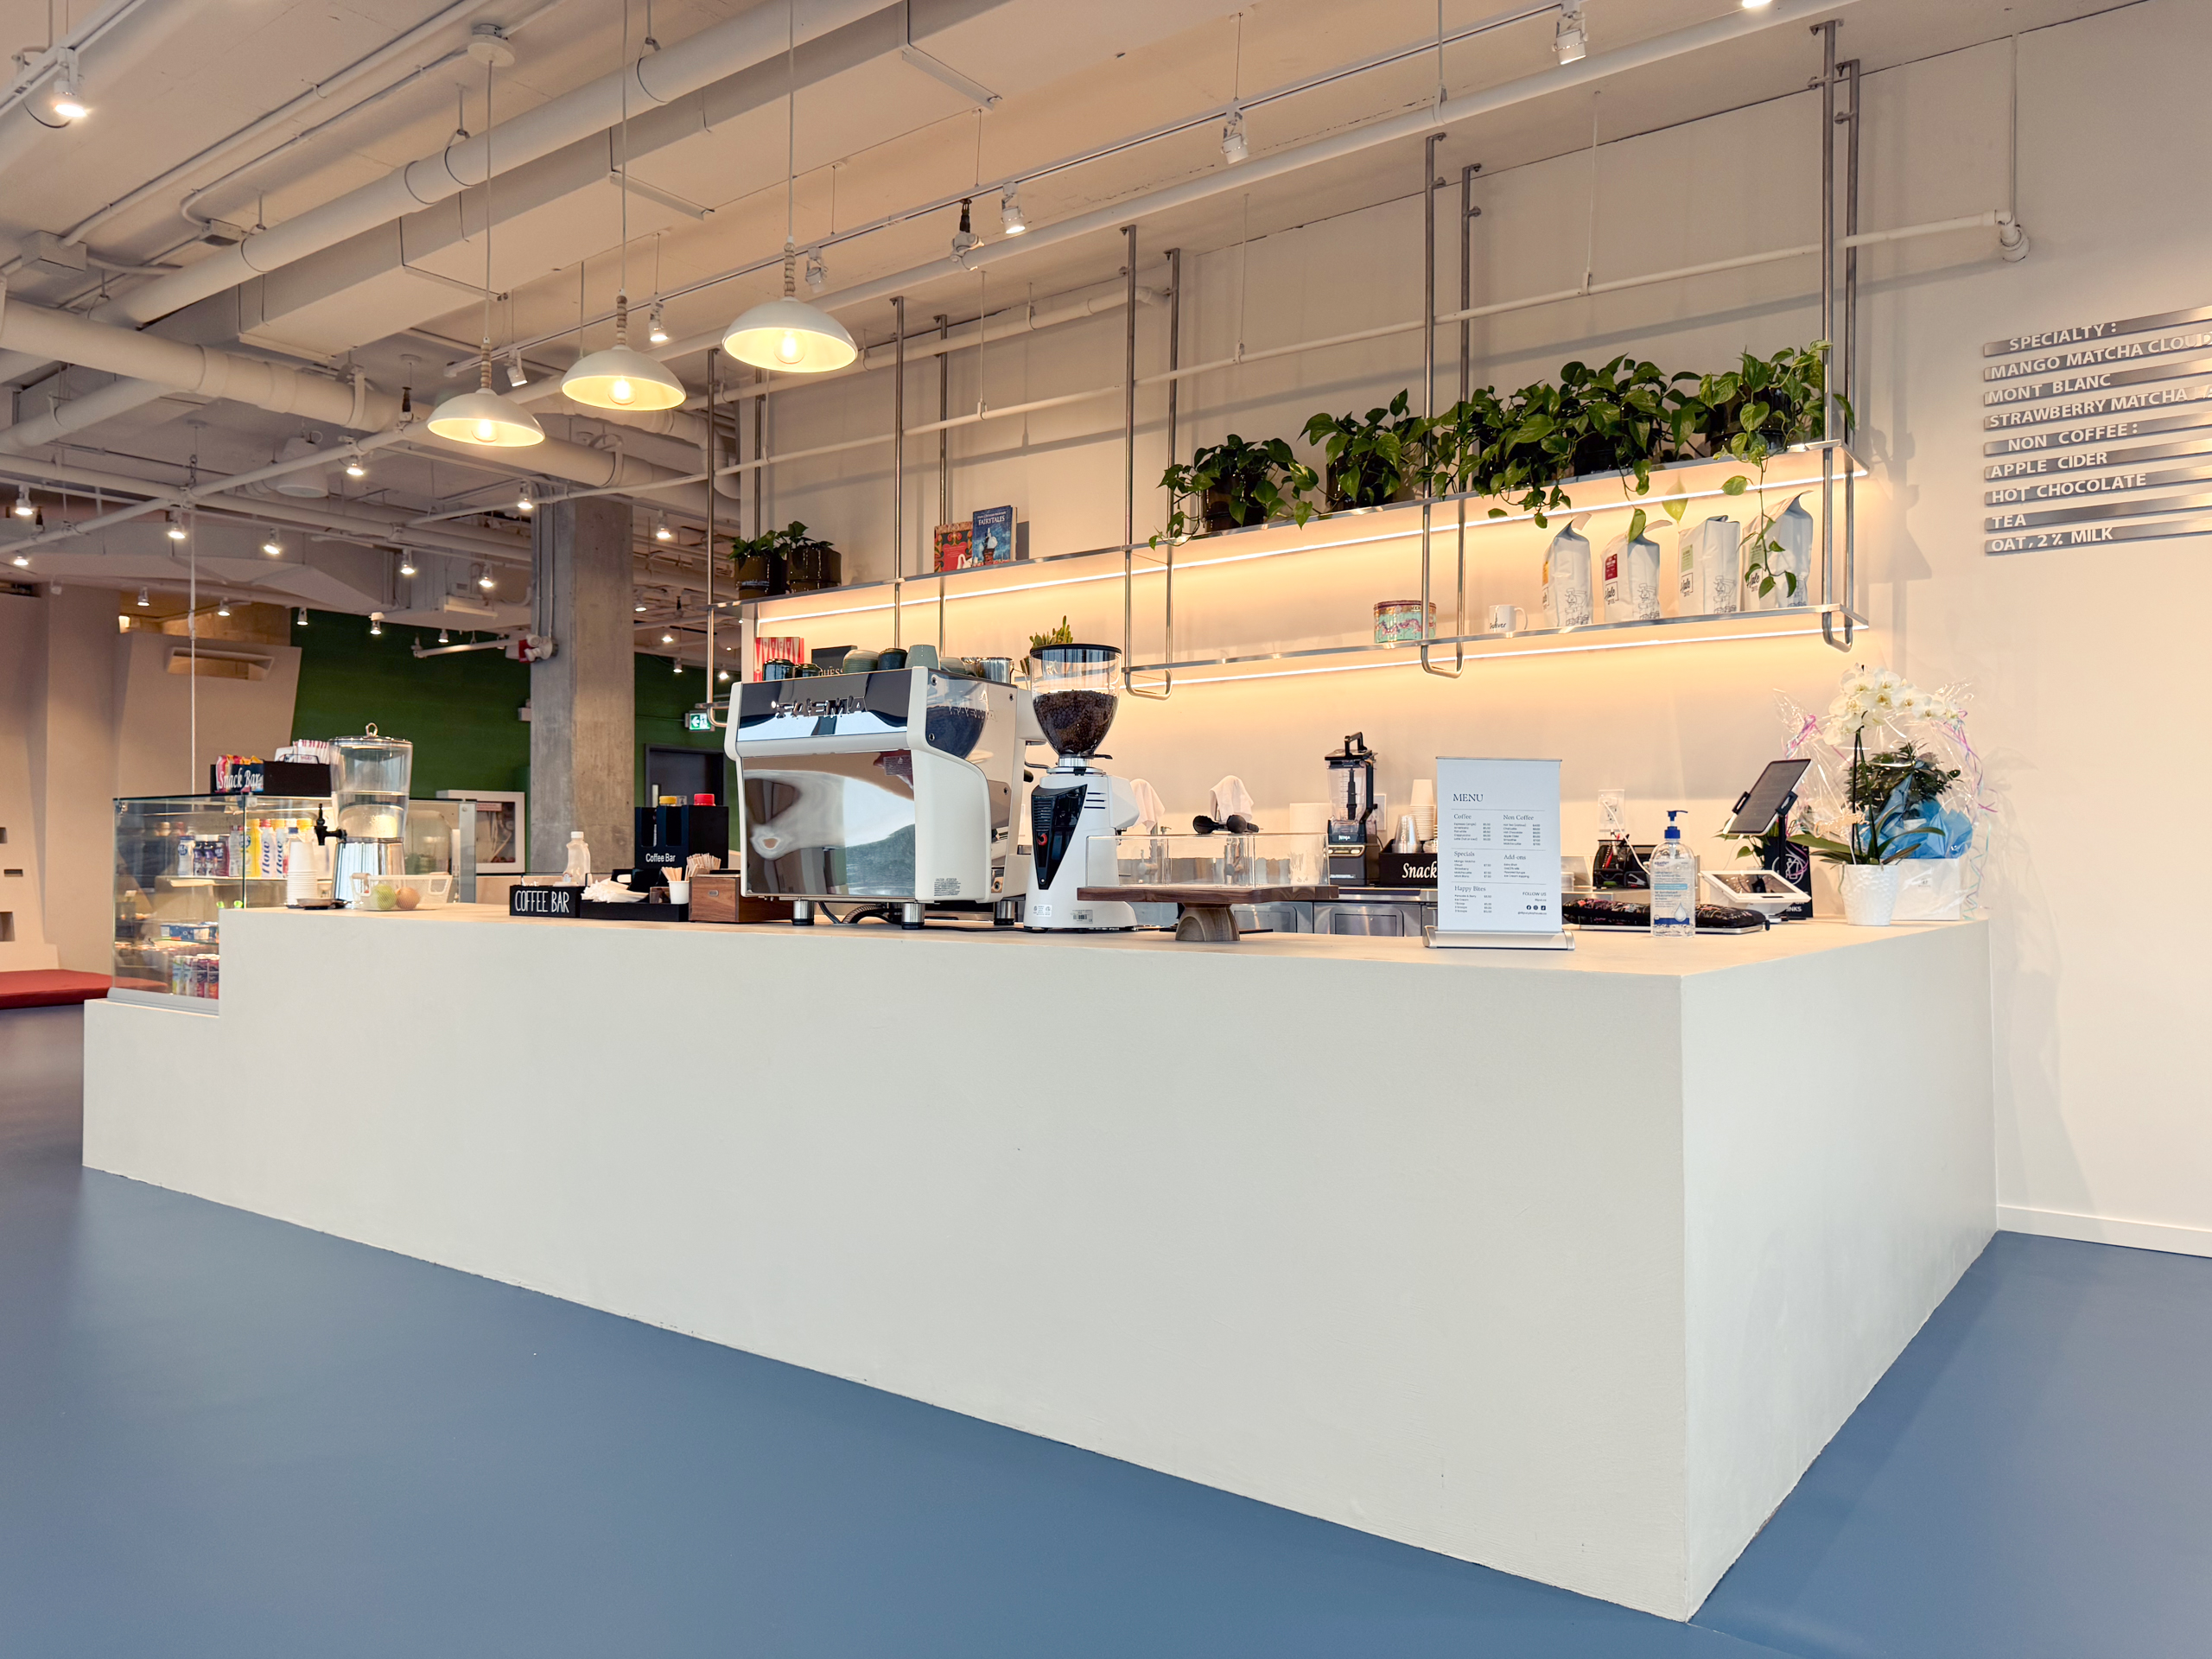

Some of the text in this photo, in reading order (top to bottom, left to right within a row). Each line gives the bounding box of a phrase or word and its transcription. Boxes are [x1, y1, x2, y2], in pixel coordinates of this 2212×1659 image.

[1991, 357, 2060, 379] MANGO
[2066, 343, 2143, 366] MATCHA
[1988, 373, 2111, 404] MONT BLANC
[1990, 399, 2104, 427] STRAWBERRY
[2110, 388, 2188, 410] MATCHA
[2008, 435, 2047, 451] NON
[1991, 452, 2107, 478] APPLE CIDER
[1992, 474, 2146, 503] HOT CHOCOLATE
[978, 515, 1005, 525] FAIRYTALES
[1992, 514, 2026, 529] TEA
[2071, 527, 2113, 543] MILK
[219, 767, 262, 789] Snack Bar
[1452, 793, 1484, 802] MENU
[645, 853, 676, 862] Coffee Bar
[1402, 861, 1438, 879] Snack
[515, 890, 569, 913] COFFEE BAR
